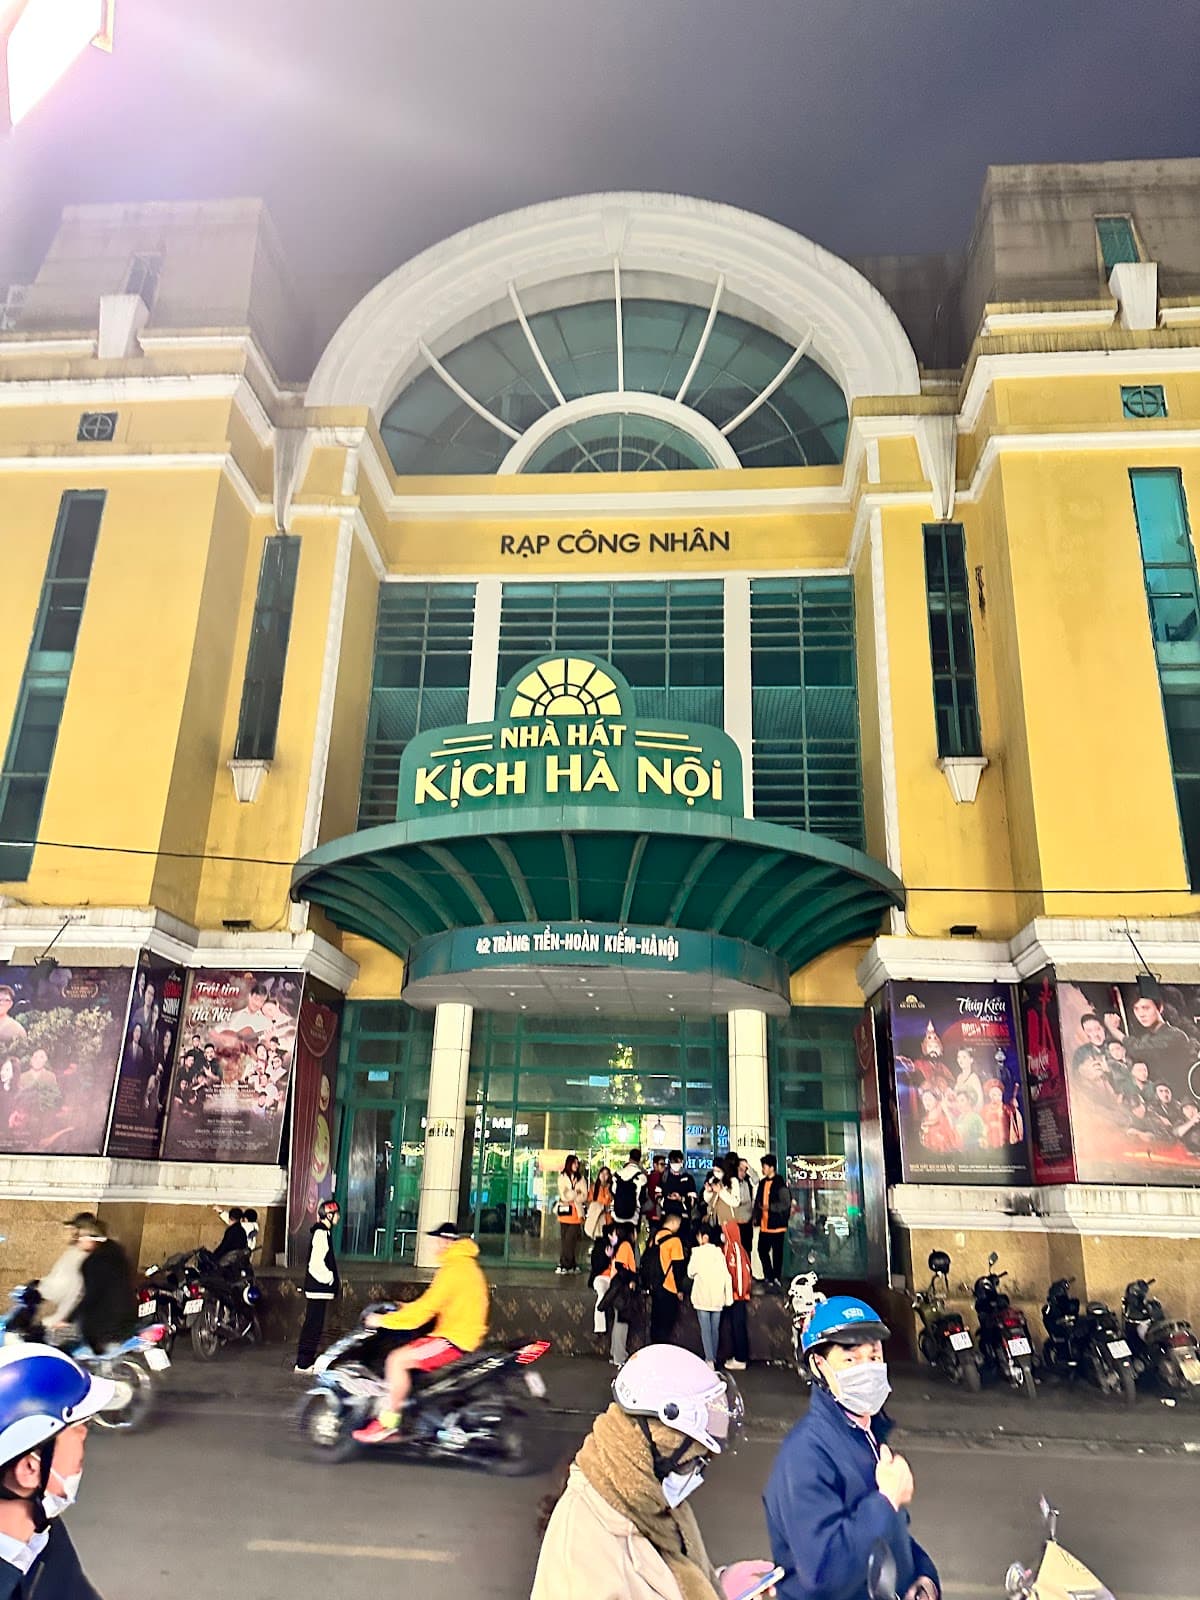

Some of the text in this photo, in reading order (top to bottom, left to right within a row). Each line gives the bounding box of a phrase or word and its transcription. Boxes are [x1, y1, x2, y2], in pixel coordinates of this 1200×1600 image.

[501, 527, 730, 558] RẠP CÔNG NHÂN
[500, 718, 627, 749] NHÀ HÁT
[546, 749, 620, 793] HÀ
[475, 937, 491, 954] 42
[492, 930, 531, 953] TRÀNG
